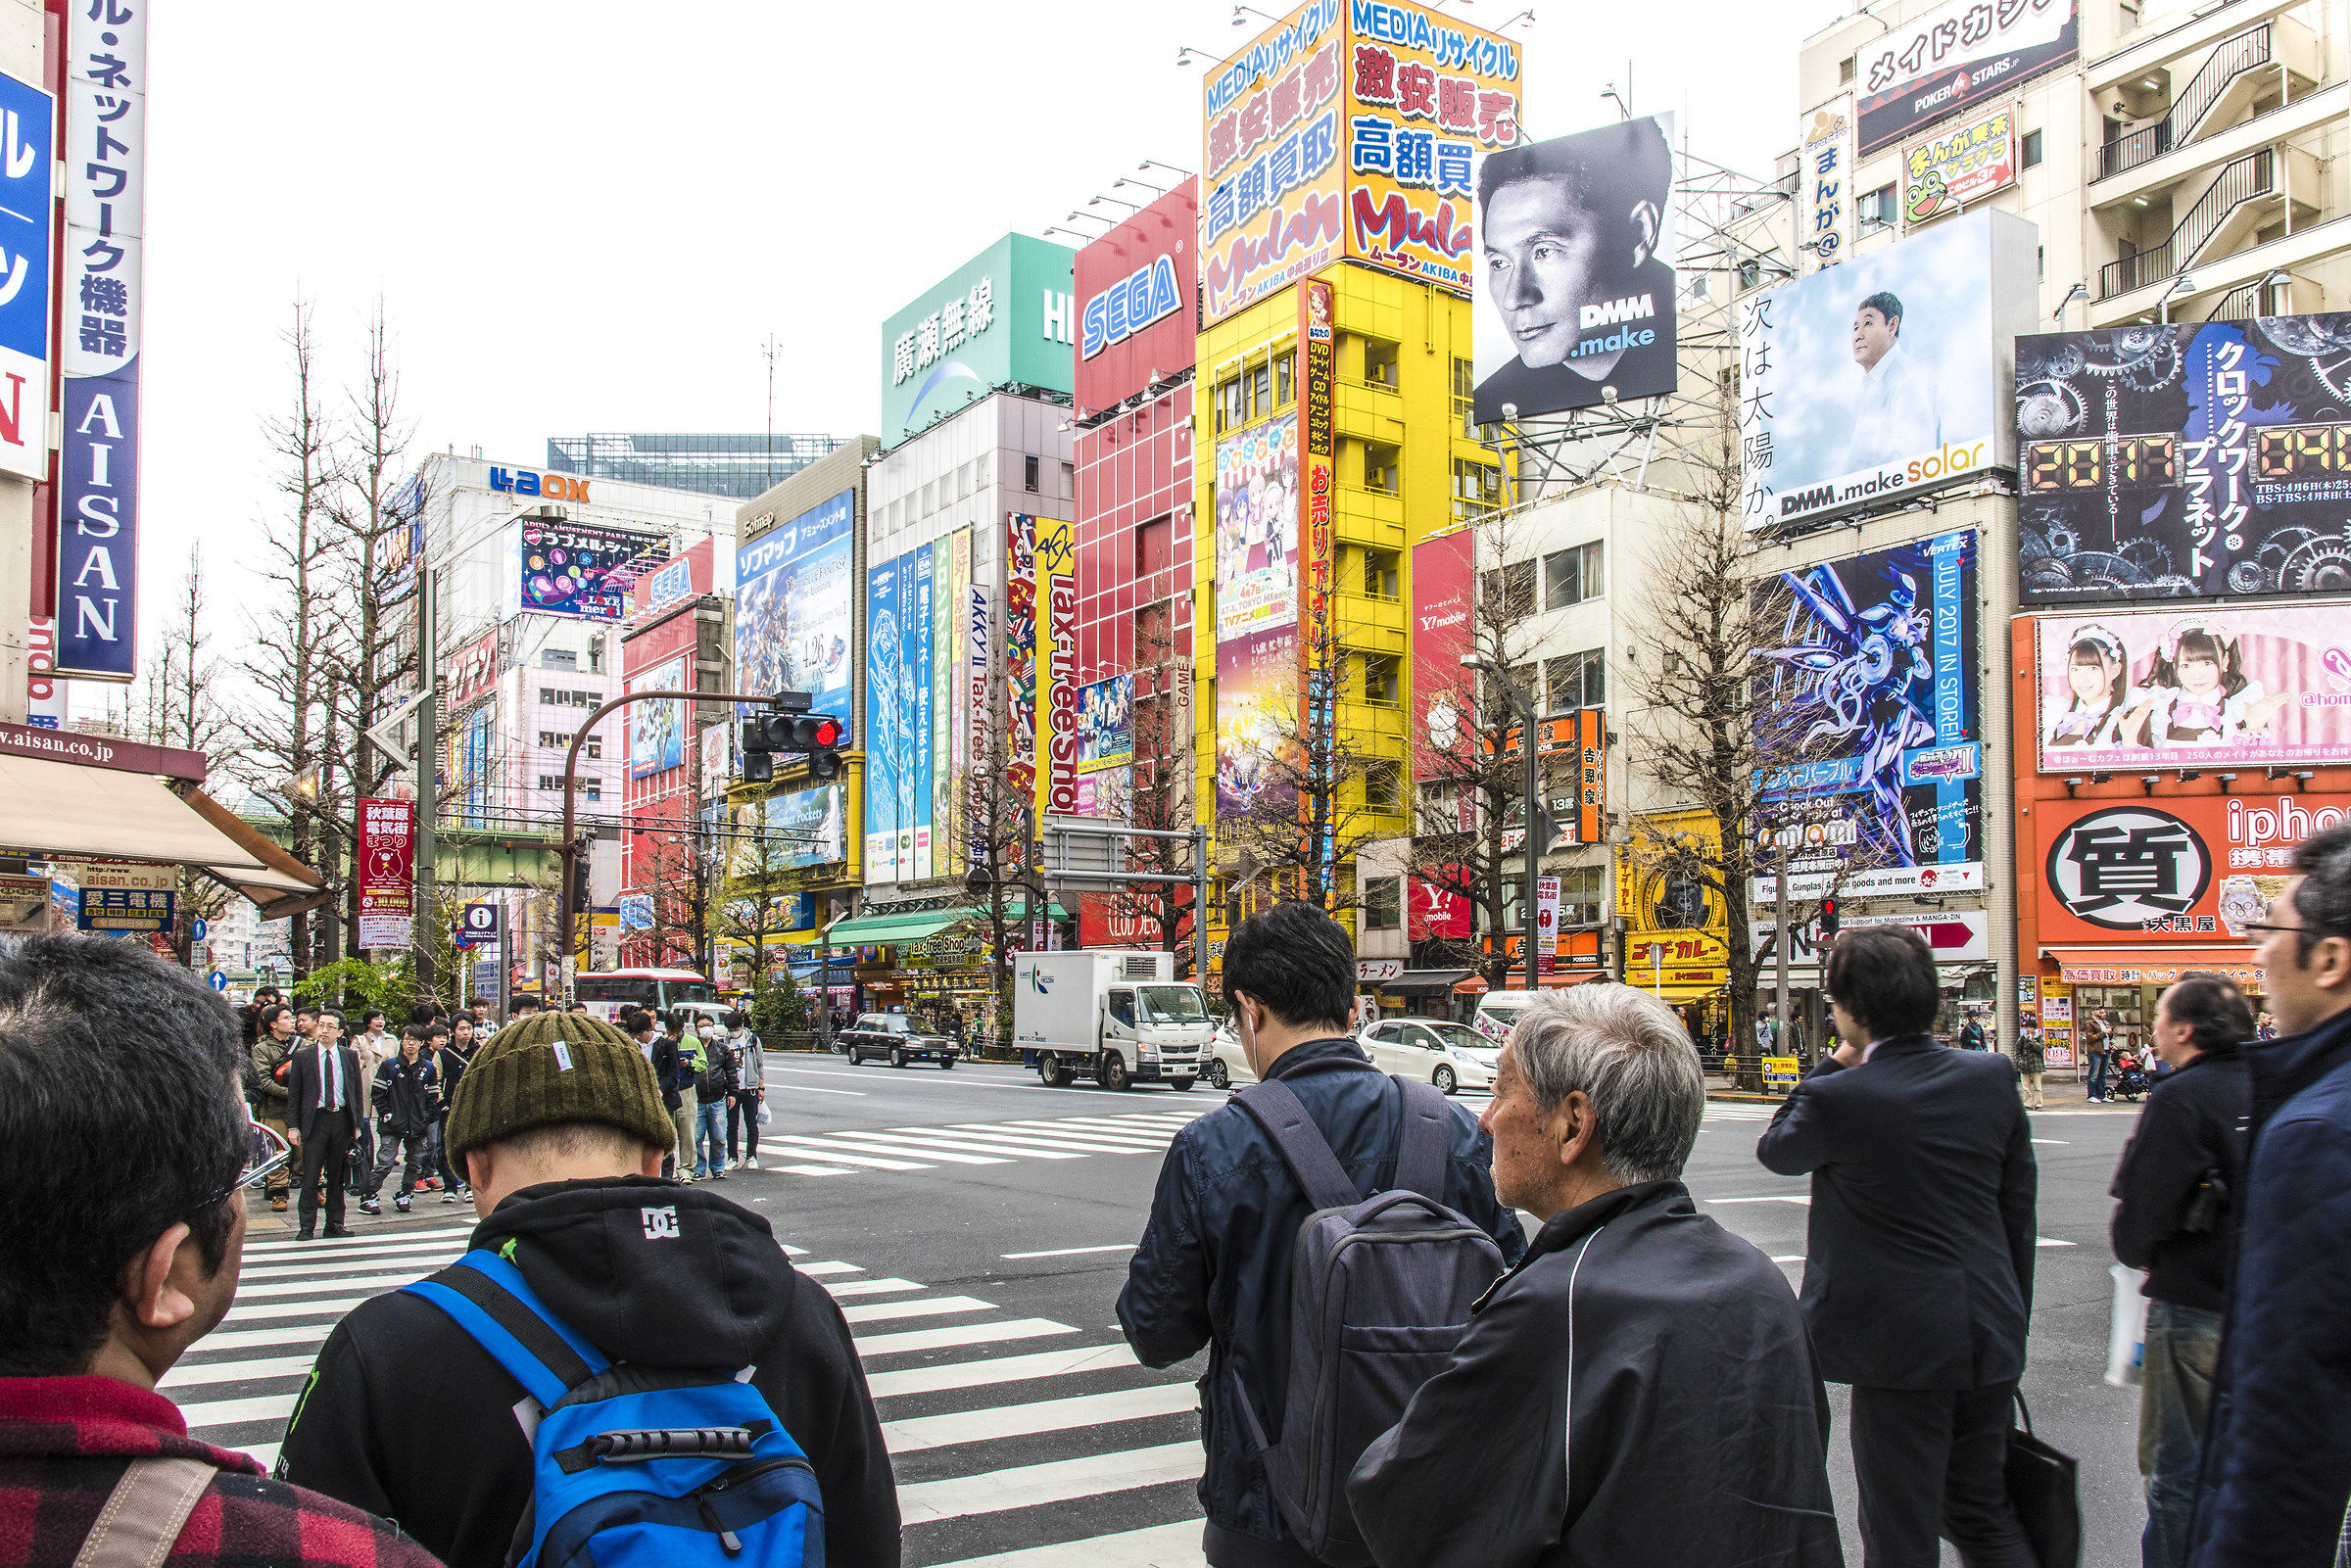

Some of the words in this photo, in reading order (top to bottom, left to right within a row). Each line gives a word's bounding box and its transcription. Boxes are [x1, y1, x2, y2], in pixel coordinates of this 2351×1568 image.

[1353, 0, 1517, 80] MEDIAリサイクル
[1354, 46, 1515, 144] 激安販売
[1914, 85, 1951, 113] POKER
[1209, 46, 1337, 174] 激安販売
[1908, 114, 2008, 180] まんが喫茶
[1946, 141, 2007, 178] ゲラゲラ
[1207, 113, 1334, 242] 高額買取
[1369, 245, 1420, 270] ムーラン
[1421, 263, 1458, 283] AKIBA
[1257, 269, 1286, 296] AKIBA
[1081, 253, 1183, 361] SEGA
[1579, 293, 1655, 331] DMM
[1309, 327, 1330, 339] あなたの
[1570, 325, 1656, 358] .make
[1310, 341, 1329, 356] DVD
[1309, 354, 1330, 366] ブルーレイ
[1309, 367, 1330, 381] ゲーム
[1313, 380, 1325, 392] CD
[1309, 392, 1330, 404] アイドル
[1310, 404, 1330, 417] アニメ
[1743, 296, 1775, 527] 次は太陽か。
[1310, 417, 1329, 430] コミック
[1311, 430, 1329, 442] ホビー
[2215, 341, 2249, 532] クロックワーク
[1310, 443, 1329, 455] フィギュア
[1908, 442, 1985, 483] solar
[2183, 435, 2218, 577] プラネット
[73, 394, 124, 642] AISAN
[744, 511, 775, 538] Sofmap
[543, 532, 632, 553] ラブメルシー
[605, 531, 627, 540] PARK
[740, 526, 797, 577] ソフマップ
[1923, 540, 1969, 557] VERTEX
[650, 556, 693, 615] SEGA
[1938, 561, 1956, 602] JULY
[1238, 595, 1262, 610] TOKYO
[972, 588, 987, 654] AKKY
[1419, 612, 1466, 632] Y!mobile
[1939, 606, 1957, 647] 2017
[936, 543, 948, 772] メロンブックス秋葉原店
[1940, 653, 1957, 672] IN
[1177, 661, 1190, 707] GAME
[972, 672, 987, 763] Tax-free
[1940, 677, 1959, 742] STORE!!
[366, 807, 408, 821] 秋葉原
[1814, 797, 1834, 809] Out
[796, 806, 823, 825] Pockets
[366, 821, 408, 834] 電気街
[366, 833, 408, 848] まつり
[2065, 821, 2194, 917] 質
[86, 874, 169, 889] aisan.co.jp
[1851, 877, 1871, 889] goods
[1872, 876, 1893, 887] and
[1895, 876, 1916, 885] more
[85, 890, 168, 909] 愛三電機
[1421, 883, 1453, 910] Y!
[620, 893, 654, 931] SEGA
[1426, 912, 1452, 922] mobile
[1848, 917, 1873, 927] Support
[1874, 917, 1883, 926] for
[2150, 916, 2216, 932] 大黒屋
[910, 936, 942, 956] Tax-free
[942, 934, 965, 954] Shop
[1019, 971, 1032, 979] KANTO
[1359, 963, 1398, 978] ラーメン
[2062, 969, 2116, 982] 高価買取
